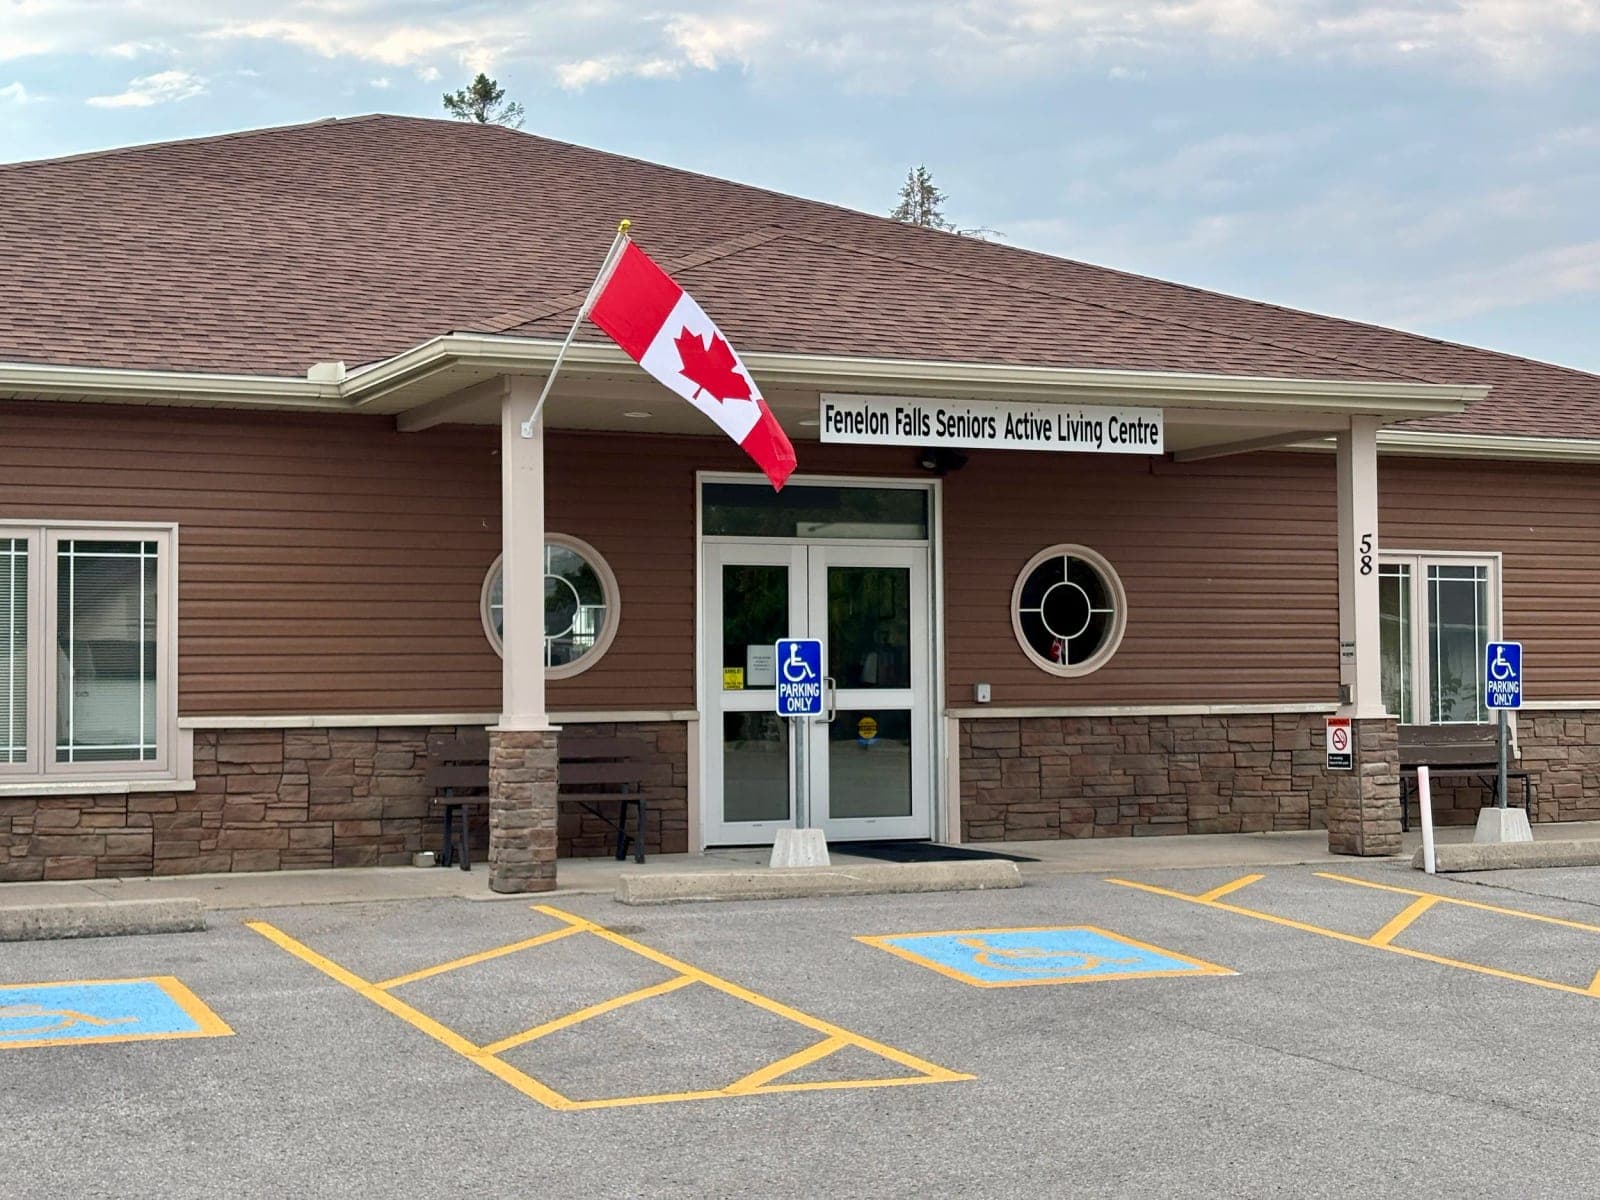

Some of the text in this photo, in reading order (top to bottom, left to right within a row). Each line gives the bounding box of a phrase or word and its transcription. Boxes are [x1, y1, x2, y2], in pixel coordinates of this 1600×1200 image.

[825, 404, 1158, 448] Fenelon Falls Seniors Active Living Centre
[780, 683, 820, 697] PARKING
[1488, 680, 1519, 693] PARKING
[787, 697, 813, 712] ONLY
[1493, 693, 1514, 706] ONLY
